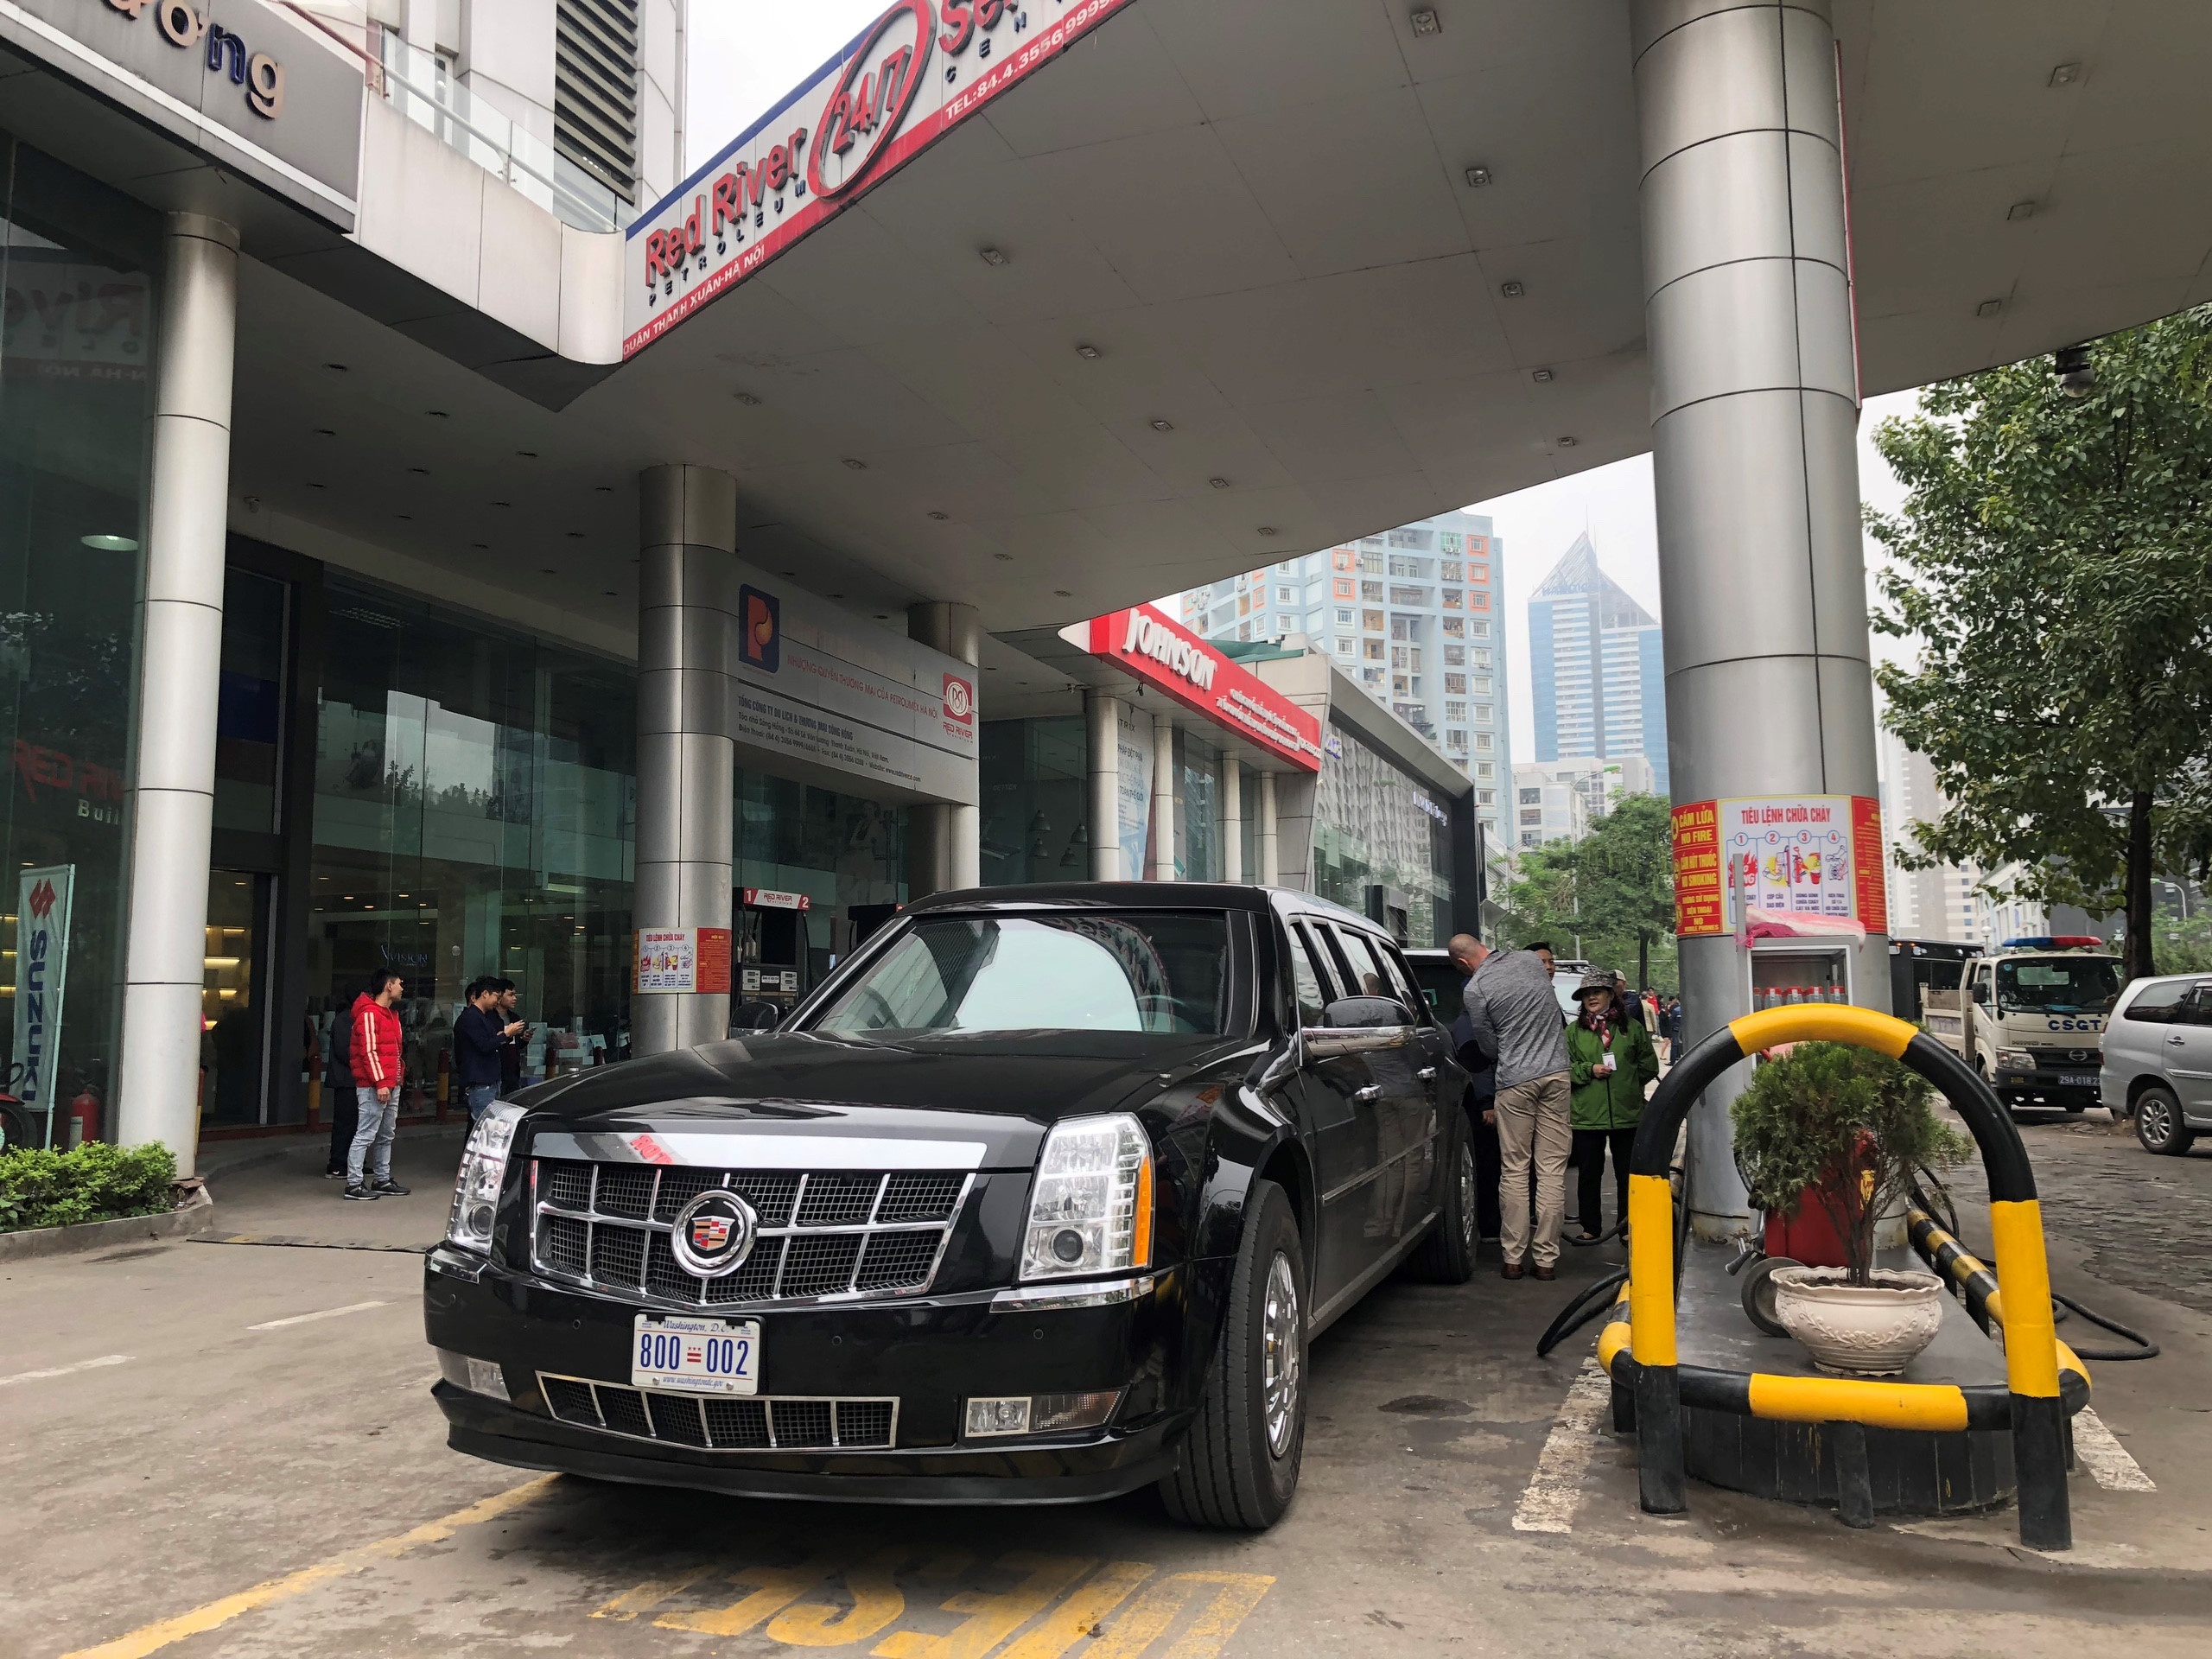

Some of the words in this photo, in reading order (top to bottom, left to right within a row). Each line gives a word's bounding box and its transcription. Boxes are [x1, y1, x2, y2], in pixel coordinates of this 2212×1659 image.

[832, 44, 912, 156] 24/7
[645, 194, 707, 288] Red
[712, 128, 807, 236] River
[649, 179, 806, 307] PETROLEUM
[623, 328, 651, 355] QUẬN
[653, 301, 687, 334] THANH
[690, 260, 741, 308] XUÂN-HÀ
[744, 244, 765, 270] NỘI
[1122, 607, 1216, 691] JOHNSON
[787, 654, 817, 674] NHƯỢNG
[876, 686, 889, 701] CỦA
[943, 721, 955, 735] RED
[956, 726, 973, 740] RIVER
[1696, 804, 1714, 825] LỬA
[1741, 806, 1759, 824] TIÊU
[1762, 805, 1783, 827] LỆNH
[1786, 804, 1808, 823] CHỮA
[1810, 804, 1831, 823] CHÁY
[1681, 832, 1691, 845] NO
[1693, 829, 1713, 843] FIRE
[1770, 833, 1776, 842] 2
[1802, 832, 1808, 842] 3
[1831, 832, 1836, 842] 4
[1688, 873, 1717, 887] SMOKING
[746, 890, 752, 902] 1
[764, 893, 775, 902] RED
[802, 896, 809, 908] 2
[1694, 917, 1703, 925] NO
[22, 929, 48, 1101] SUZUKI
[2048, 1020, 2101, 1031] CSGT
[640, 1333, 680, 1370] 800
[706, 1338, 749, 1376] 002
